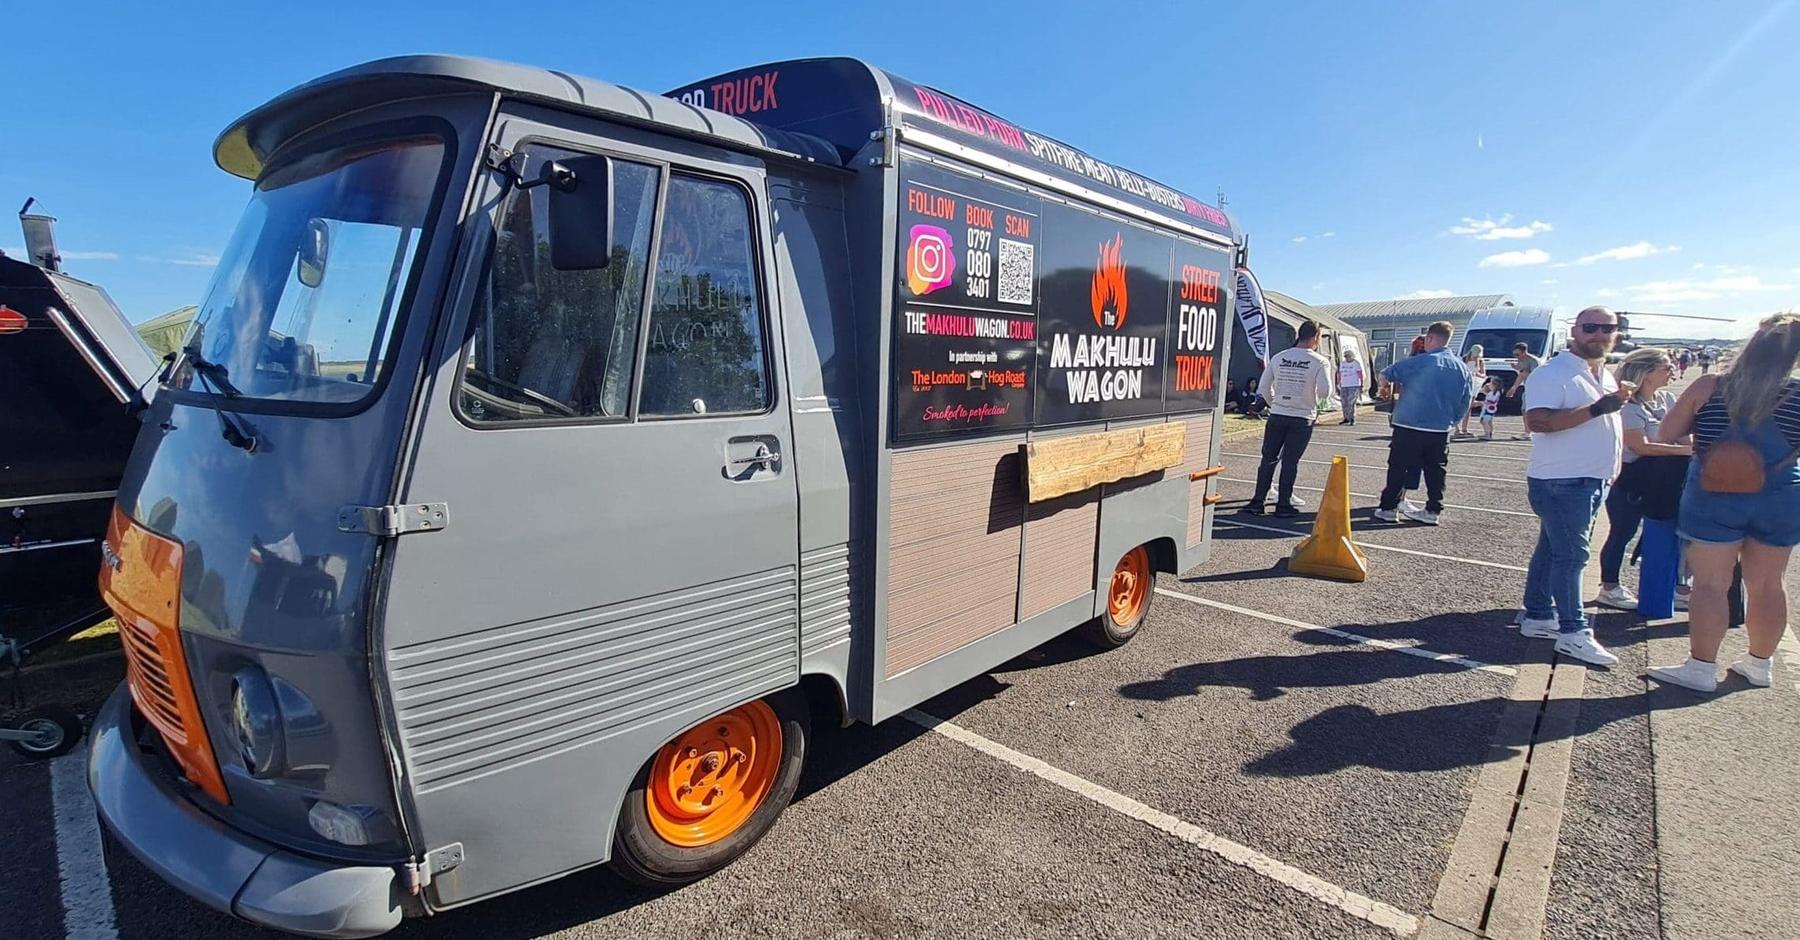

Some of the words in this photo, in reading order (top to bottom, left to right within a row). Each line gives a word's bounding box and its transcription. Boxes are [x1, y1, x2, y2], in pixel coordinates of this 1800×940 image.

[711, 71, 778, 116] TRUCK
[913, 86, 984, 136] PULLED
[981, 114, 1028, 152] PORK
[1023, 131, 1084, 174] SPITFIRE
[1079, 154, 1117, 187] MEATY
[908, 189, 955, 221] FOLLOW
[966, 204, 994, 229] BOOK
[1005, 215, 1029, 238] SCAN
[967, 228, 991, 250] 0797
[966, 250, 991, 278] 080
[966, 278, 990, 298] 3401
[1181, 264, 1220, 304] STREET
[905, 312, 1034, 340] THEMAKHULUWAGON.CO.UK
[1104, 310, 1116, 326] The
[1177, 304, 1217, 351] FOOD
[949, 350, 956, 362] In
[955, 350, 986, 365] partnership
[986, 351, 998, 363] with
[1050, 333, 1157, 368] MAKHULU
[911, 369, 930, 385] The
[931, 370, 966, 385] London
[988, 370, 1004, 387] Hog
[1005, 370, 1025, 384] Roast
[1066, 369, 1143, 404] WAGON
[1176, 355, 1214, 391] TRUCK
[923, 402, 959, 421] Smoked
[959, 406, 968, 419] to
[968, 402, 1010, 422] perfection!
